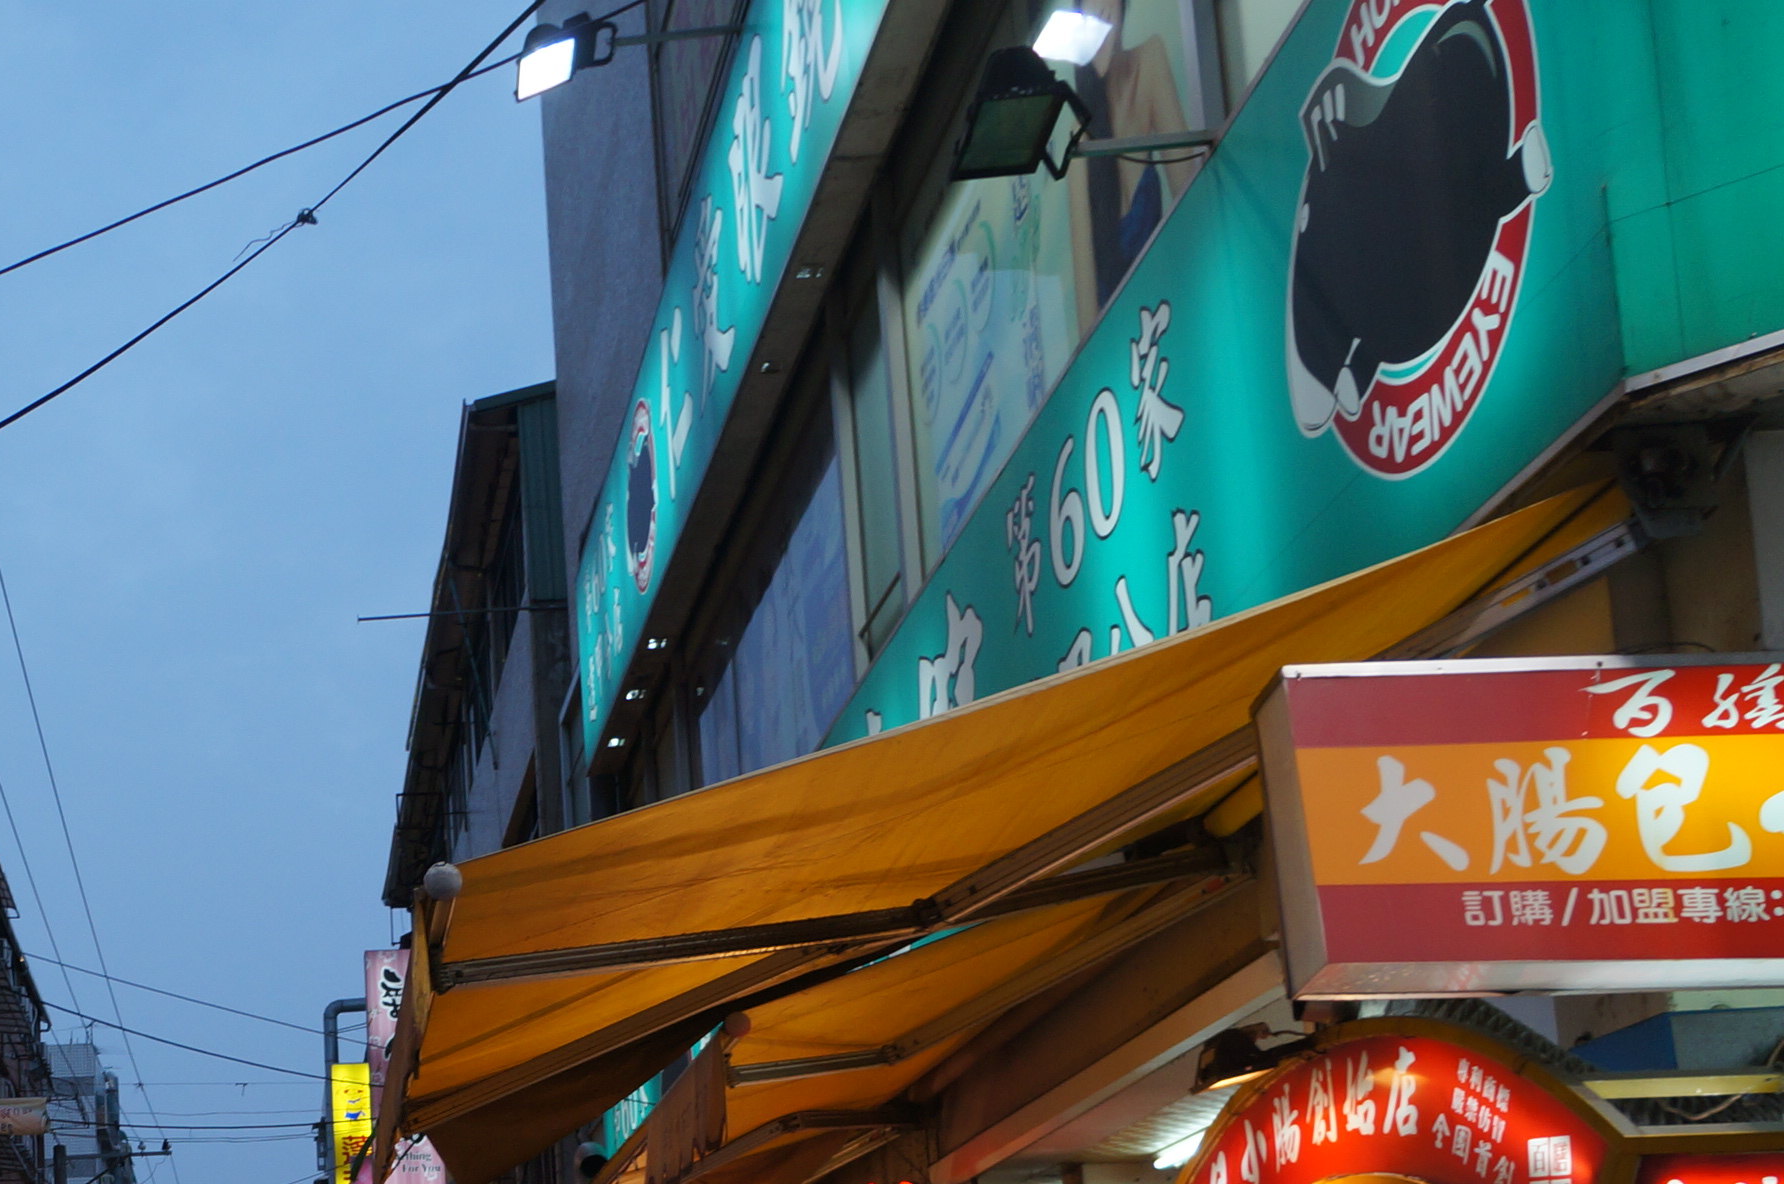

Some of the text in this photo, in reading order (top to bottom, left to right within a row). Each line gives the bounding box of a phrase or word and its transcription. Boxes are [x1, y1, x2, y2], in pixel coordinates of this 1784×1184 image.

[1368, 250, 1515, 463] EYEWEAR
[1006, 300, 1186, 637] 第60家
[1358, 744, 1784, 877] 大腸包
[401, 1163, 441, 1174] For You
